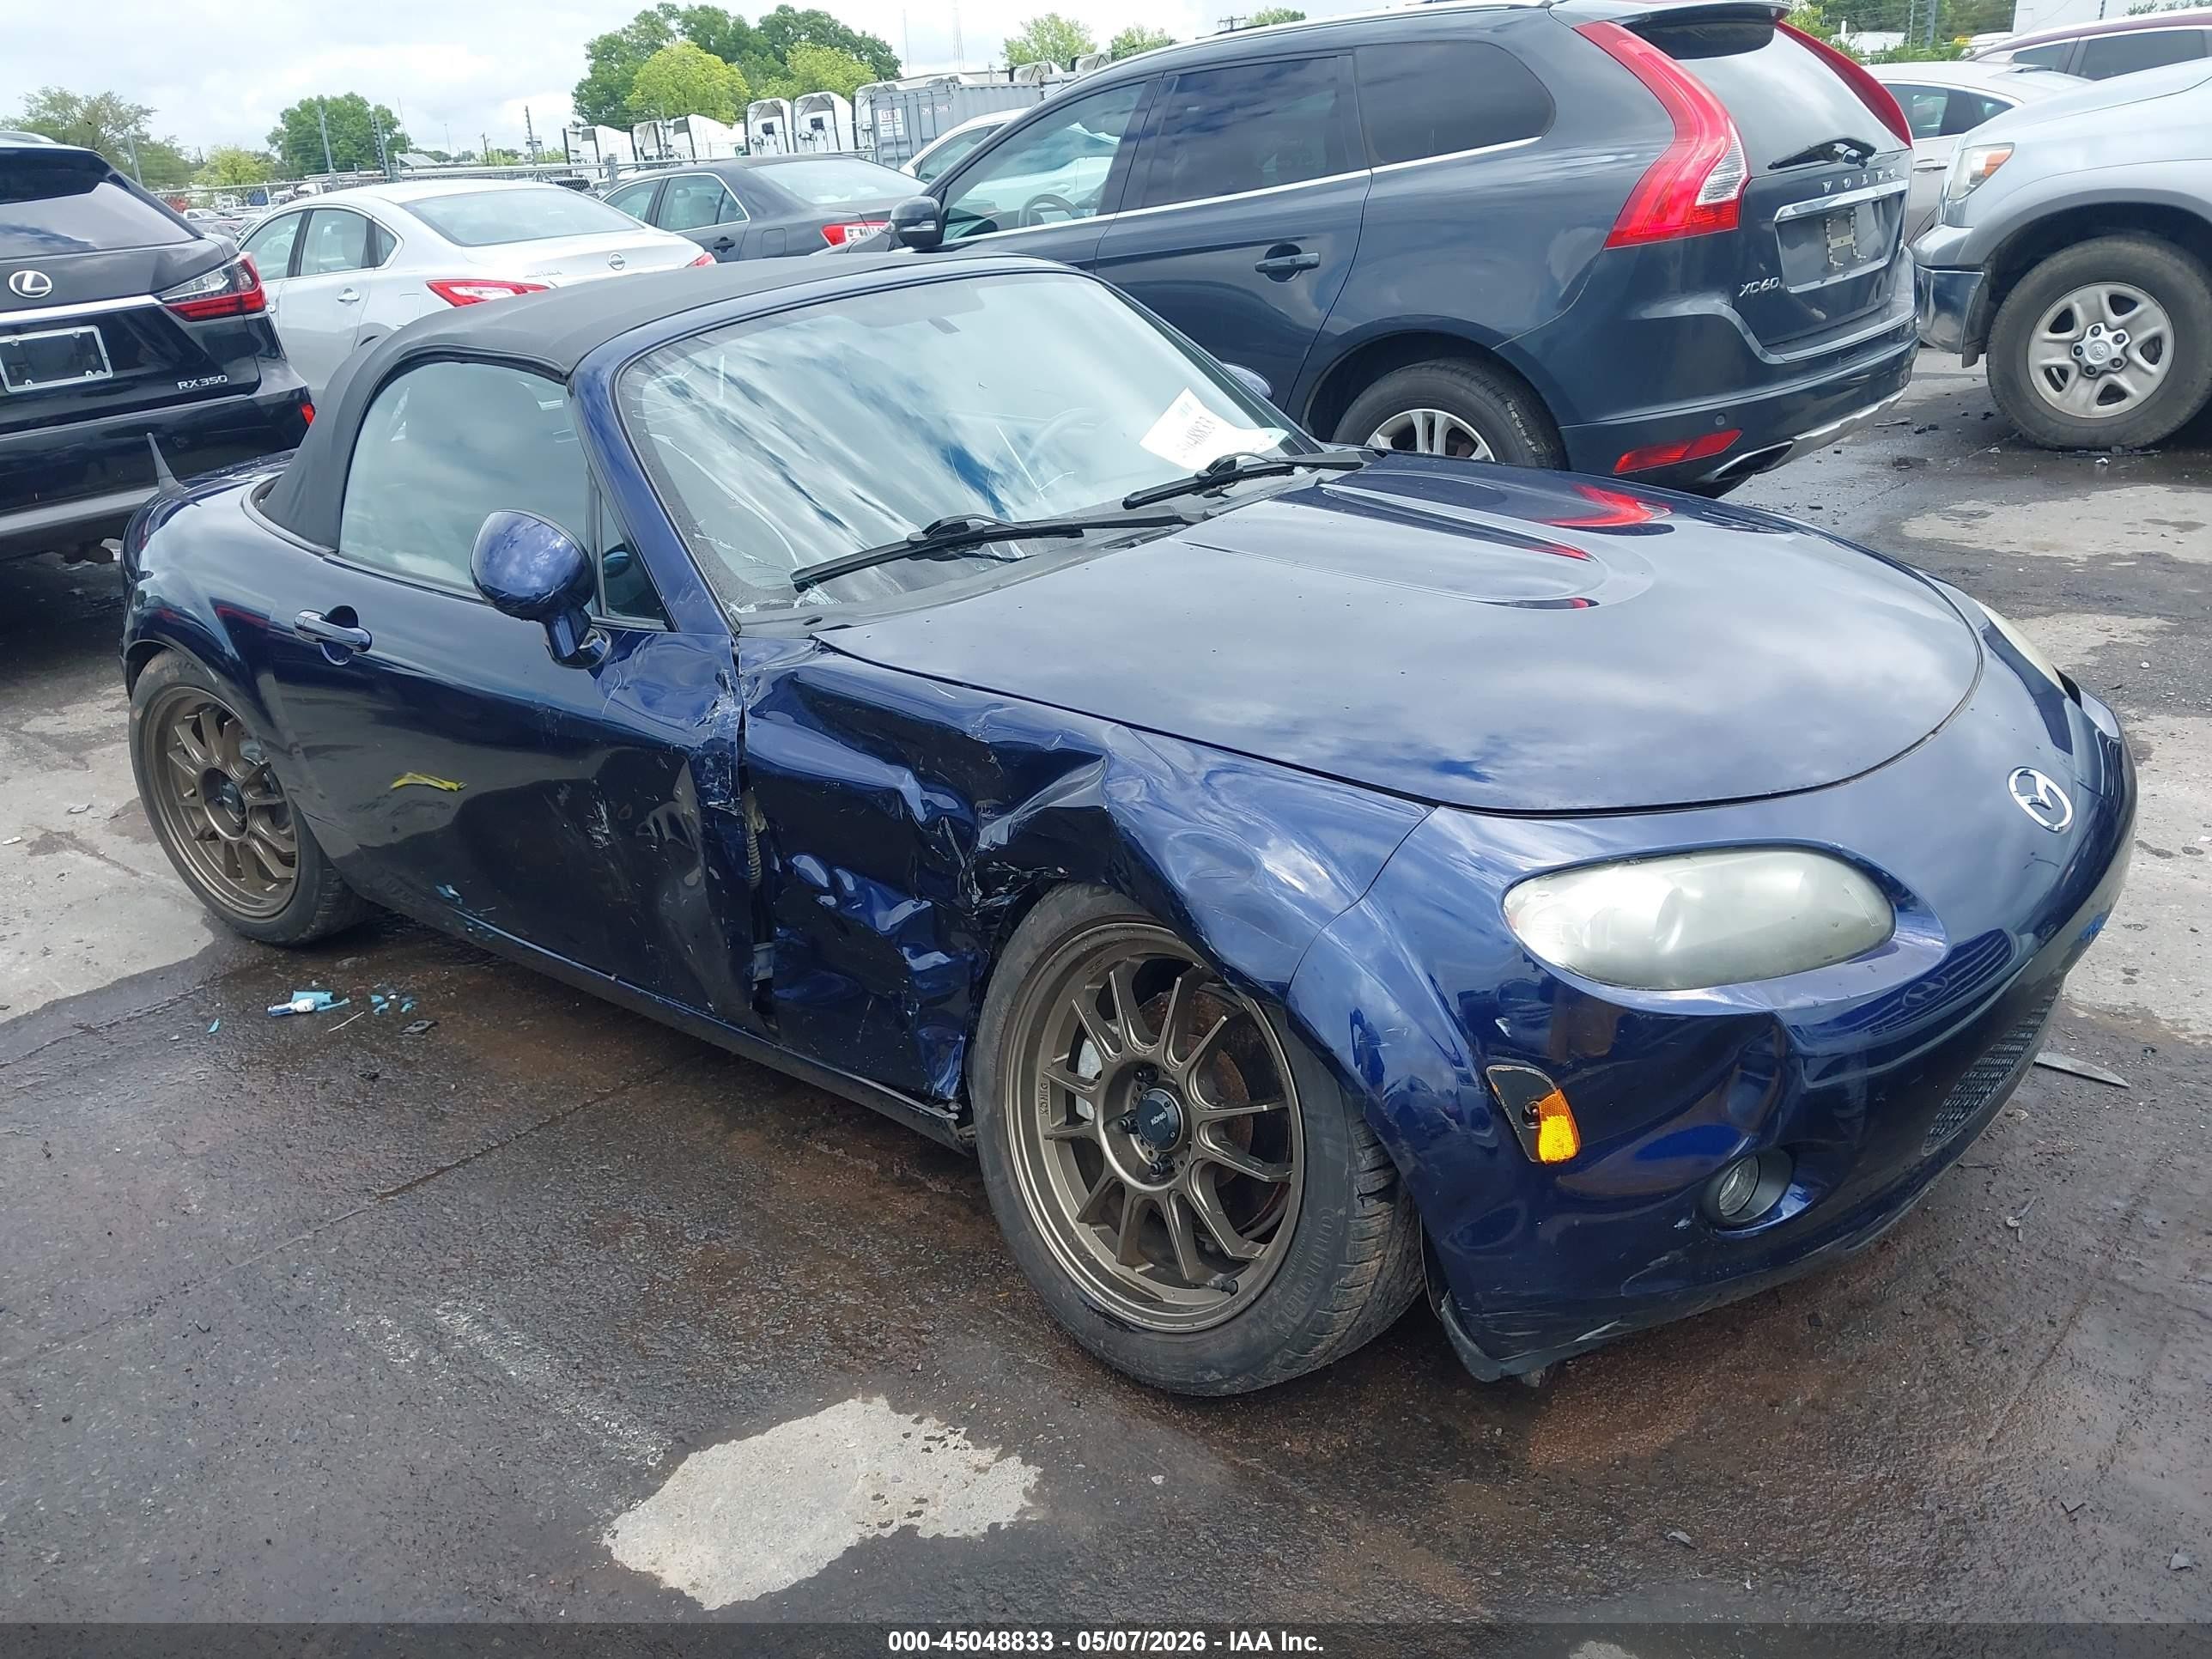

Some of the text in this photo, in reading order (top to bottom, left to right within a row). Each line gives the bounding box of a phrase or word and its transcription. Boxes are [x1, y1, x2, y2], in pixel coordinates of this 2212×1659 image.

[1822, 167, 1896, 193] VOLVO
[1739, 276, 1780, 297] XC60
[177, 374, 228, 390] RX350
